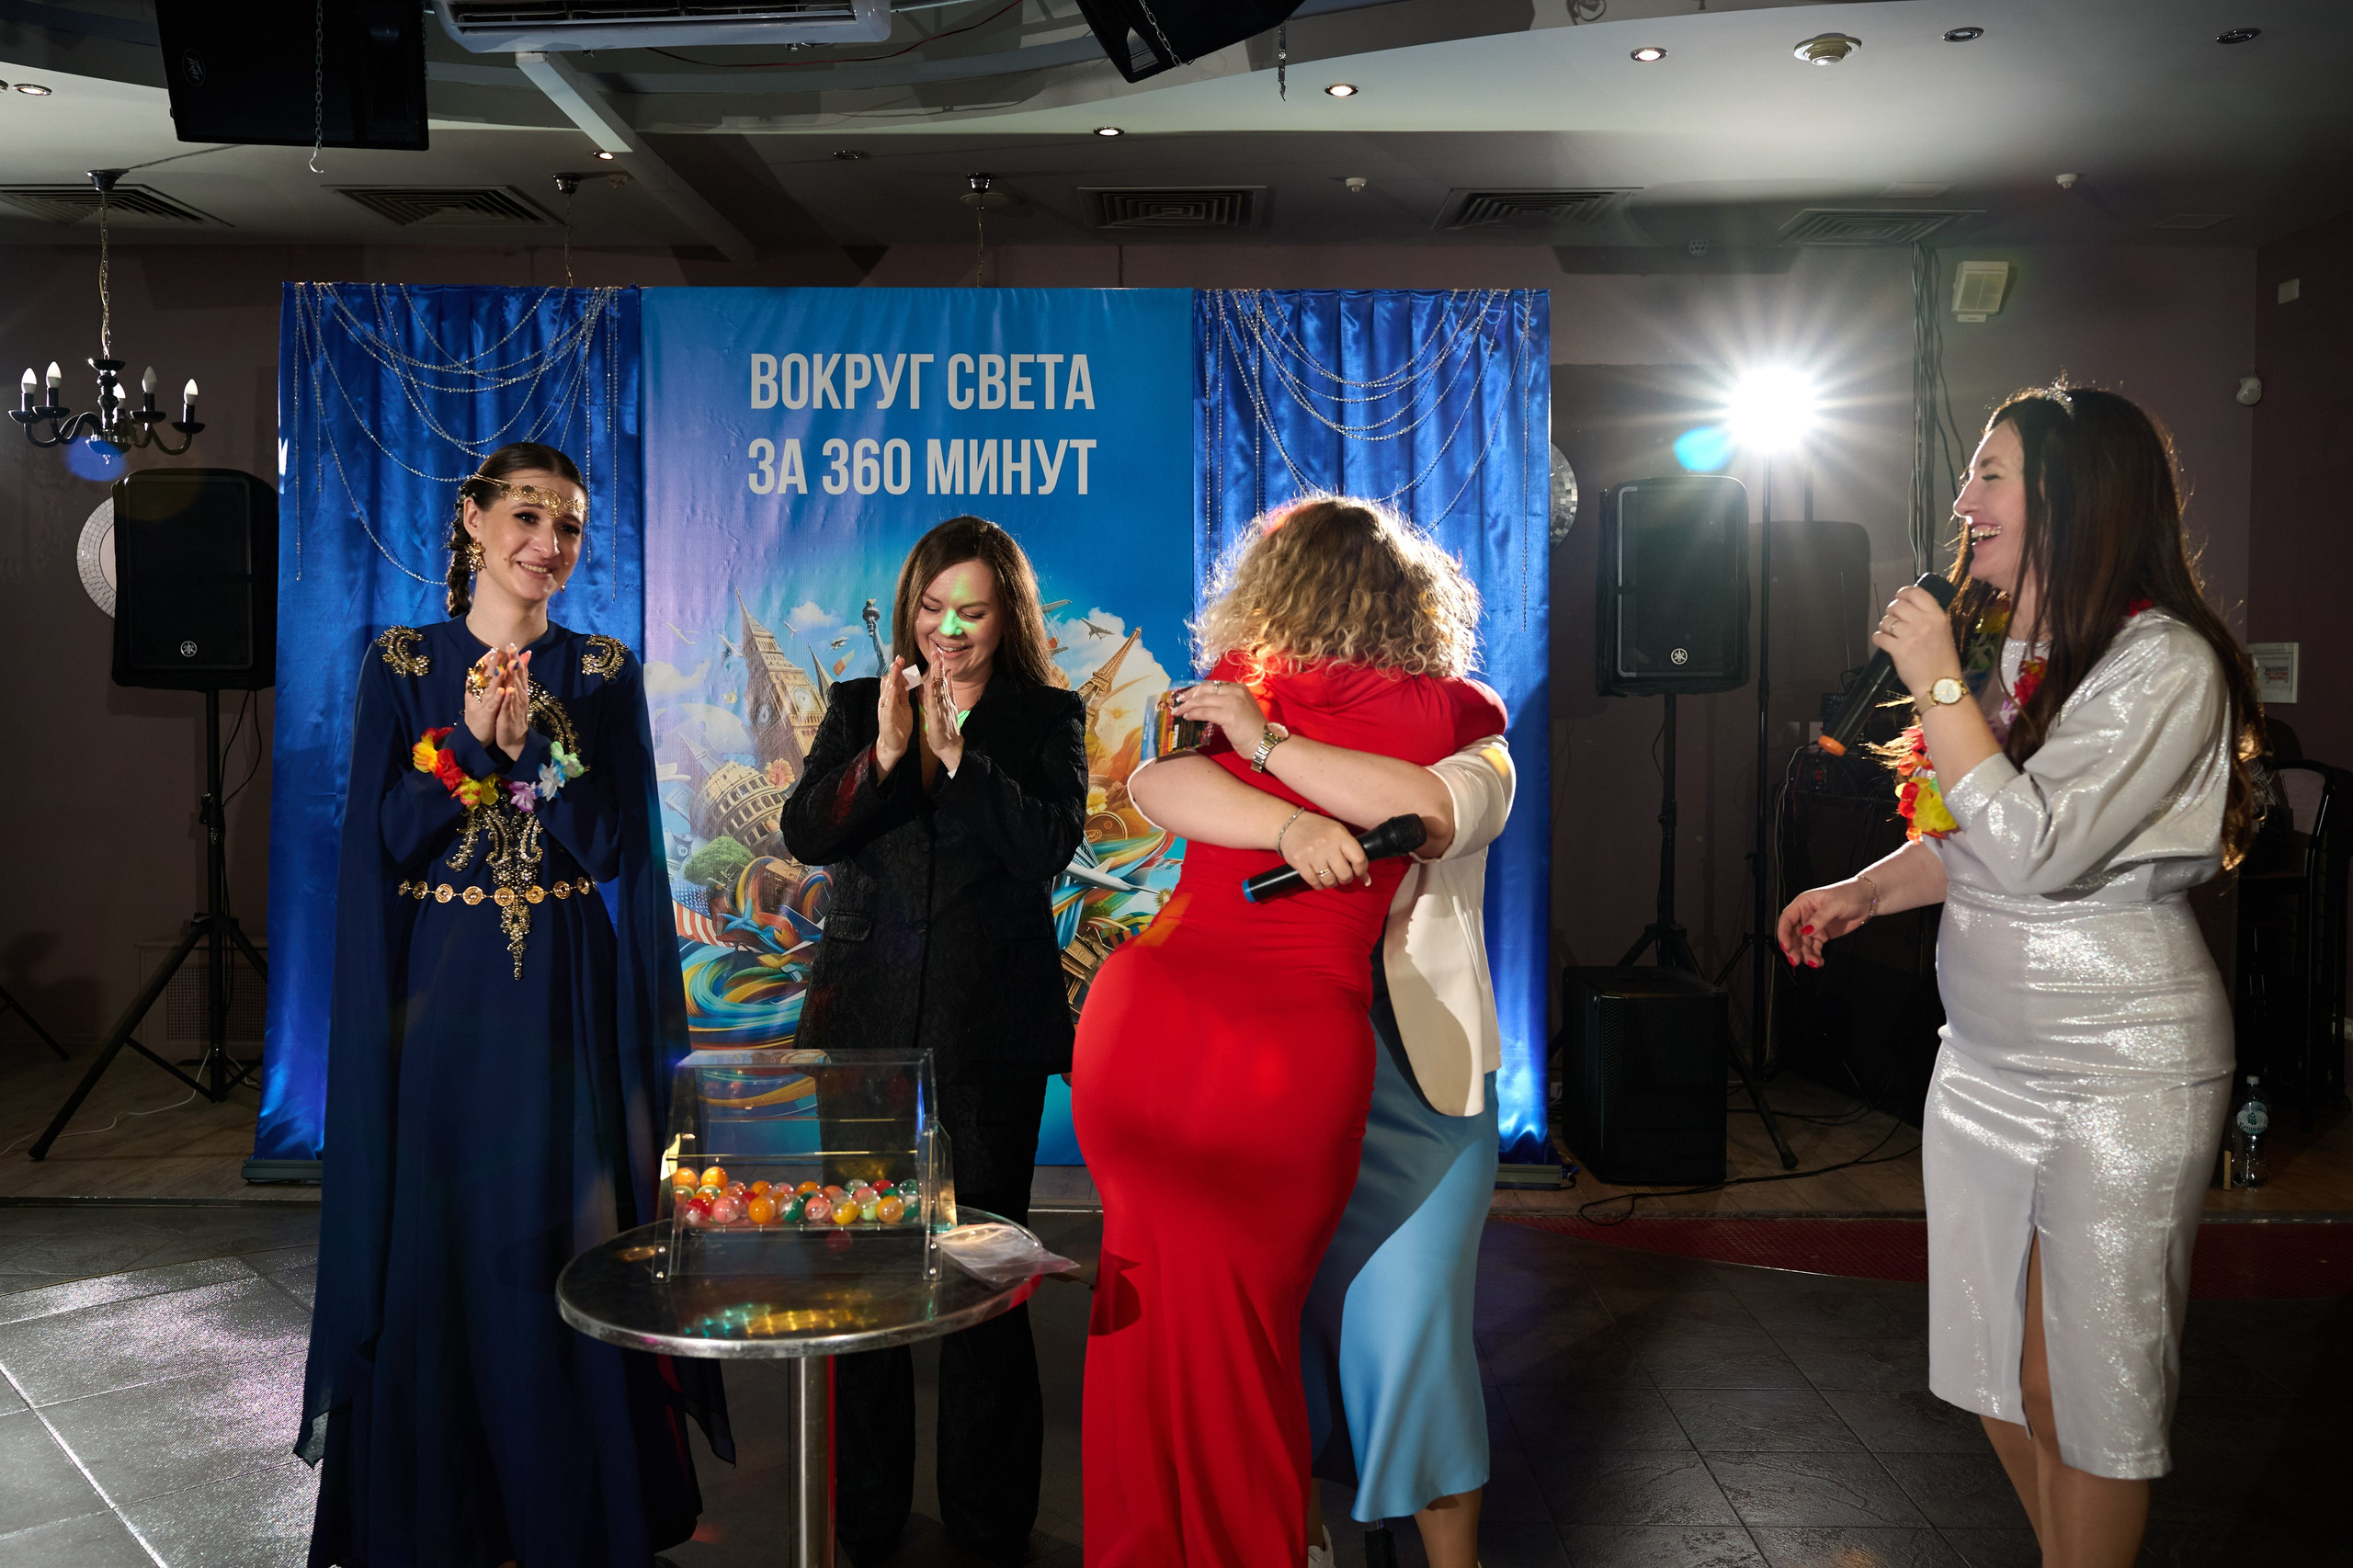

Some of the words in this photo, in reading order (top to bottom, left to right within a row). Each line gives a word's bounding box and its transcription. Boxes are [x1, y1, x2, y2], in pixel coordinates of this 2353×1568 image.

[752, 354, 933, 409] ВОКРУГ
[949, 354, 1095, 409] СВЕТА
[749, 438, 807, 494] ЗА
[823, 438, 910, 494] 360
[927, 439, 1096, 494] МИНУТ
